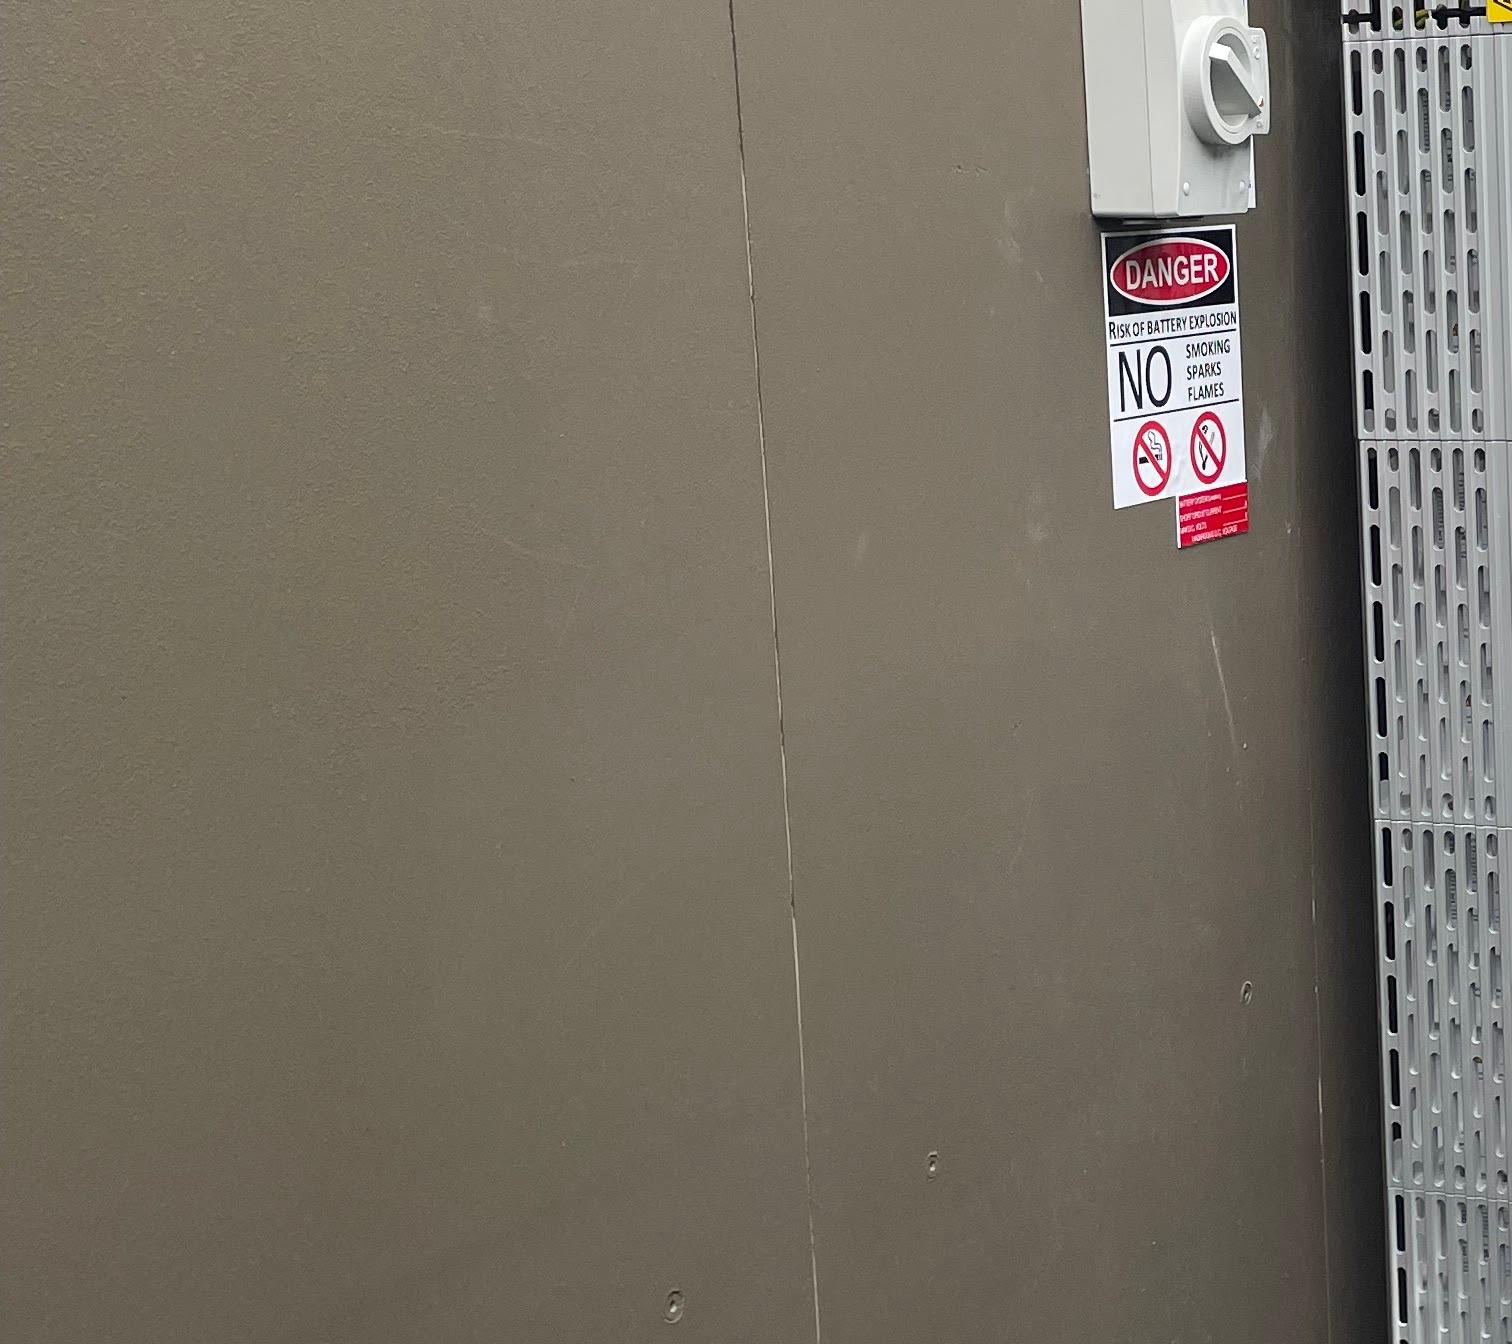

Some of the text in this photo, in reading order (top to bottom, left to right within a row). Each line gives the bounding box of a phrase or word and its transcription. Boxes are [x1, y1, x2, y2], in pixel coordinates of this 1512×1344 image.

[1125, 253, 1220, 291] DANGER
[1132, 321, 1145, 337] OF
[1147, 316, 1188, 335] BATTERY
[1189, 311, 1237, 330] EXPLOSION
[1186, 338, 1231, 359] SMOKING
[1118, 345, 1172, 413] NO
[1186, 361, 1222, 381] SPARKS
[1187, 382, 1225, 402] FLAMES
